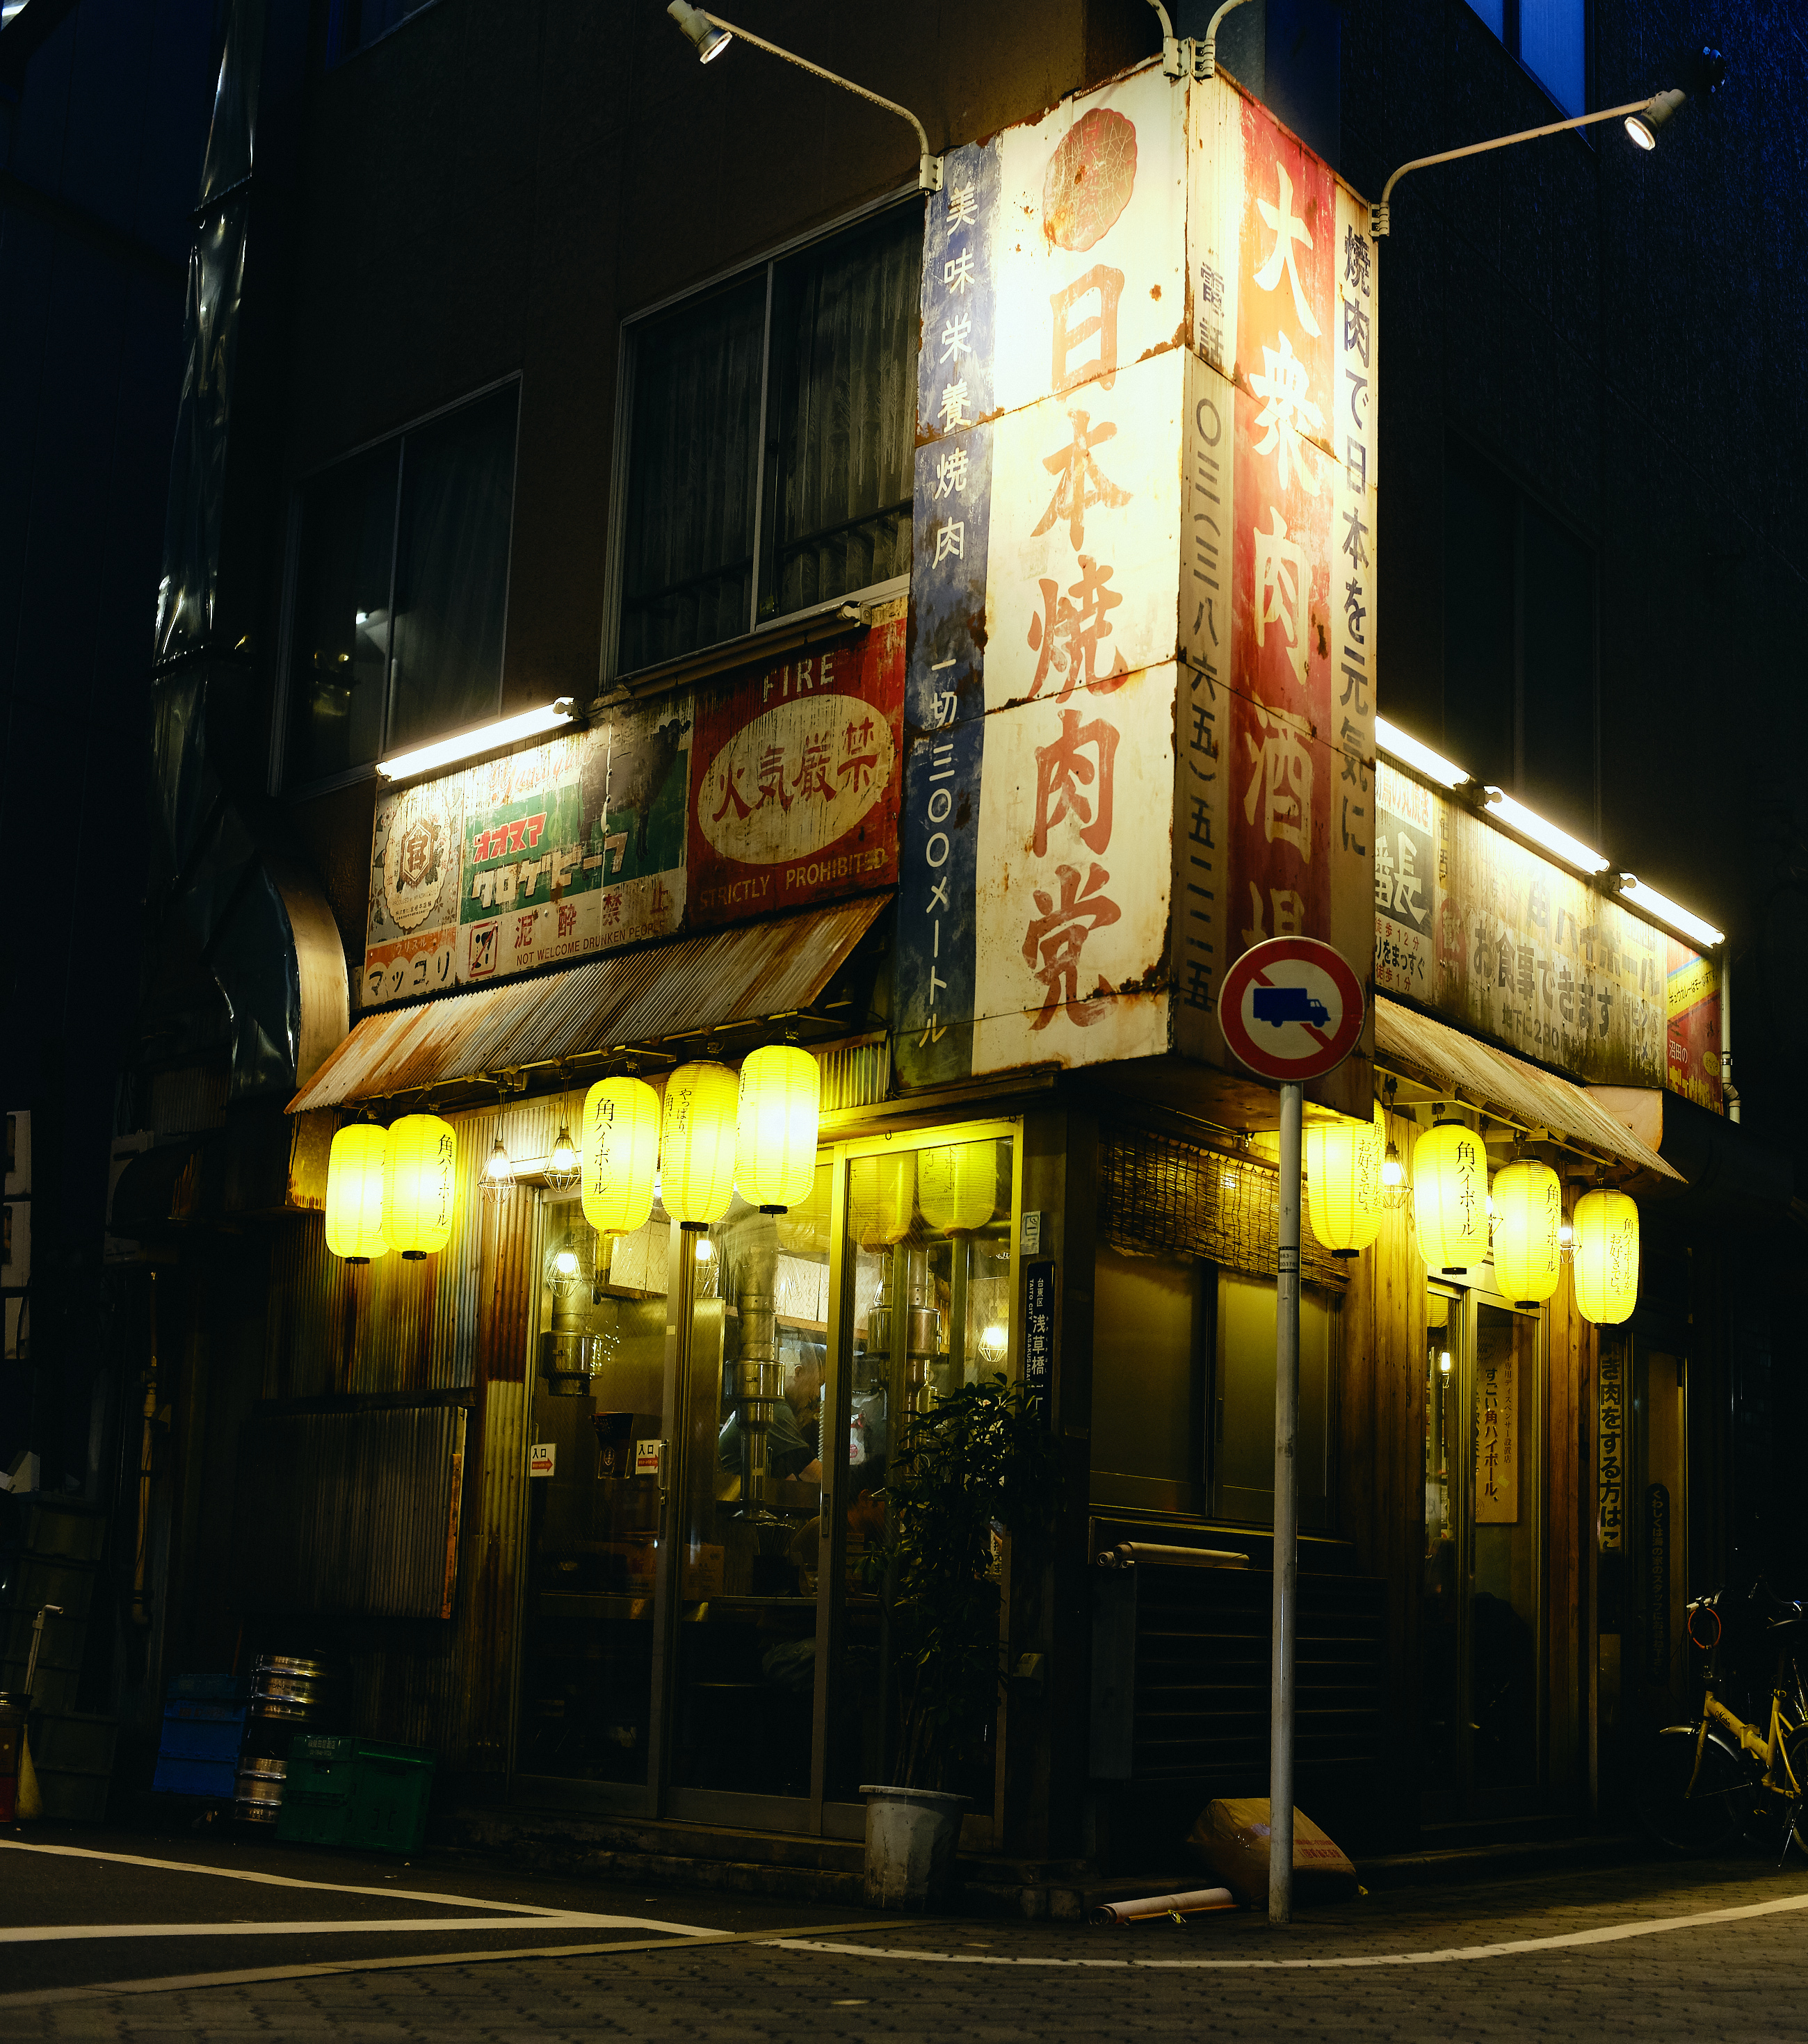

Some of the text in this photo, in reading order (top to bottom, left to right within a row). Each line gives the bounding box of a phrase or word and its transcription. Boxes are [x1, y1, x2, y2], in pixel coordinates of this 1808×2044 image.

[1341, 225, 1372, 857] 焼肉で日本を元気に
[763, 652, 835, 702] FIRE
[1022, 263, 1134, 1032] 日本焼肉党
[712, 717, 881, 822] 火気厳禁
[473, 811, 548, 864] オオヌマ
[700, 847, 889, 910] STRICTLY PROHIBITED
[514, 881, 669, 950] 泥酔禁止
[516, 920, 665, 967] NOT WELCOME DRUNKEN PEOPLE
[369, 951, 451, 996] マッコリ
[1474, 922, 1614, 1038] お食事できます
[592, 1098, 615, 1197] 角ハイボール
[677, 1089, 692, 1135] やっぱり、
[435, 1134, 453, 1227] 角ハイボール
[1455, 1141, 1477, 1238] 角ハイボール
[1545, 1184, 1558, 1272] 角ハイボール
[532, 1447, 547, 1459] 入口
[638, 1444, 654, 1456] 入口
[1485, 1368, 1499, 1502] すごい角ハイボール、
[1599, 1342, 1622, 1550] き肉をする方はこ
